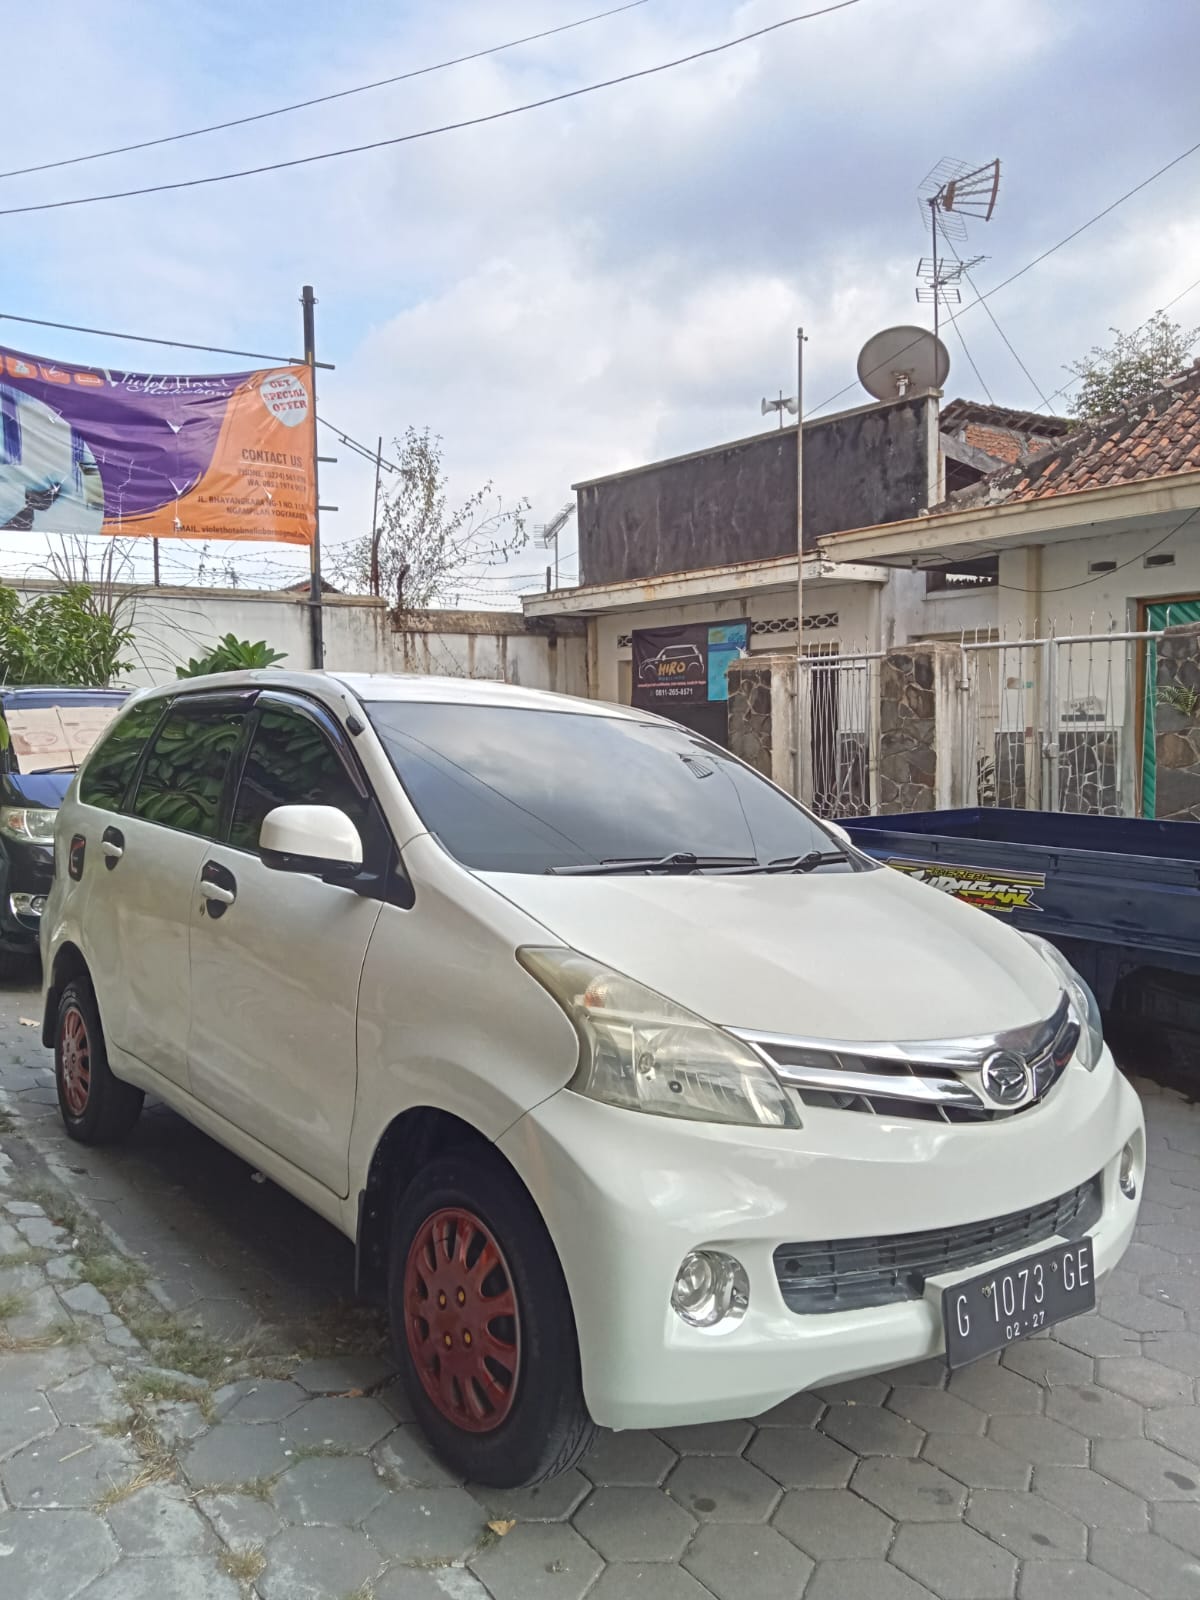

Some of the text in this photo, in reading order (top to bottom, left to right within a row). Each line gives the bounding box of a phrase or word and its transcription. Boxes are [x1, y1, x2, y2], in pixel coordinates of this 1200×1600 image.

[269, 379, 291, 388] GET
[272, 400, 308, 412] OFFER
[241, 448, 303, 467] CONTACT US
[658, 661, 686, 675] HIRO
[957, 1247, 1089, 1337] G 1073 GE
